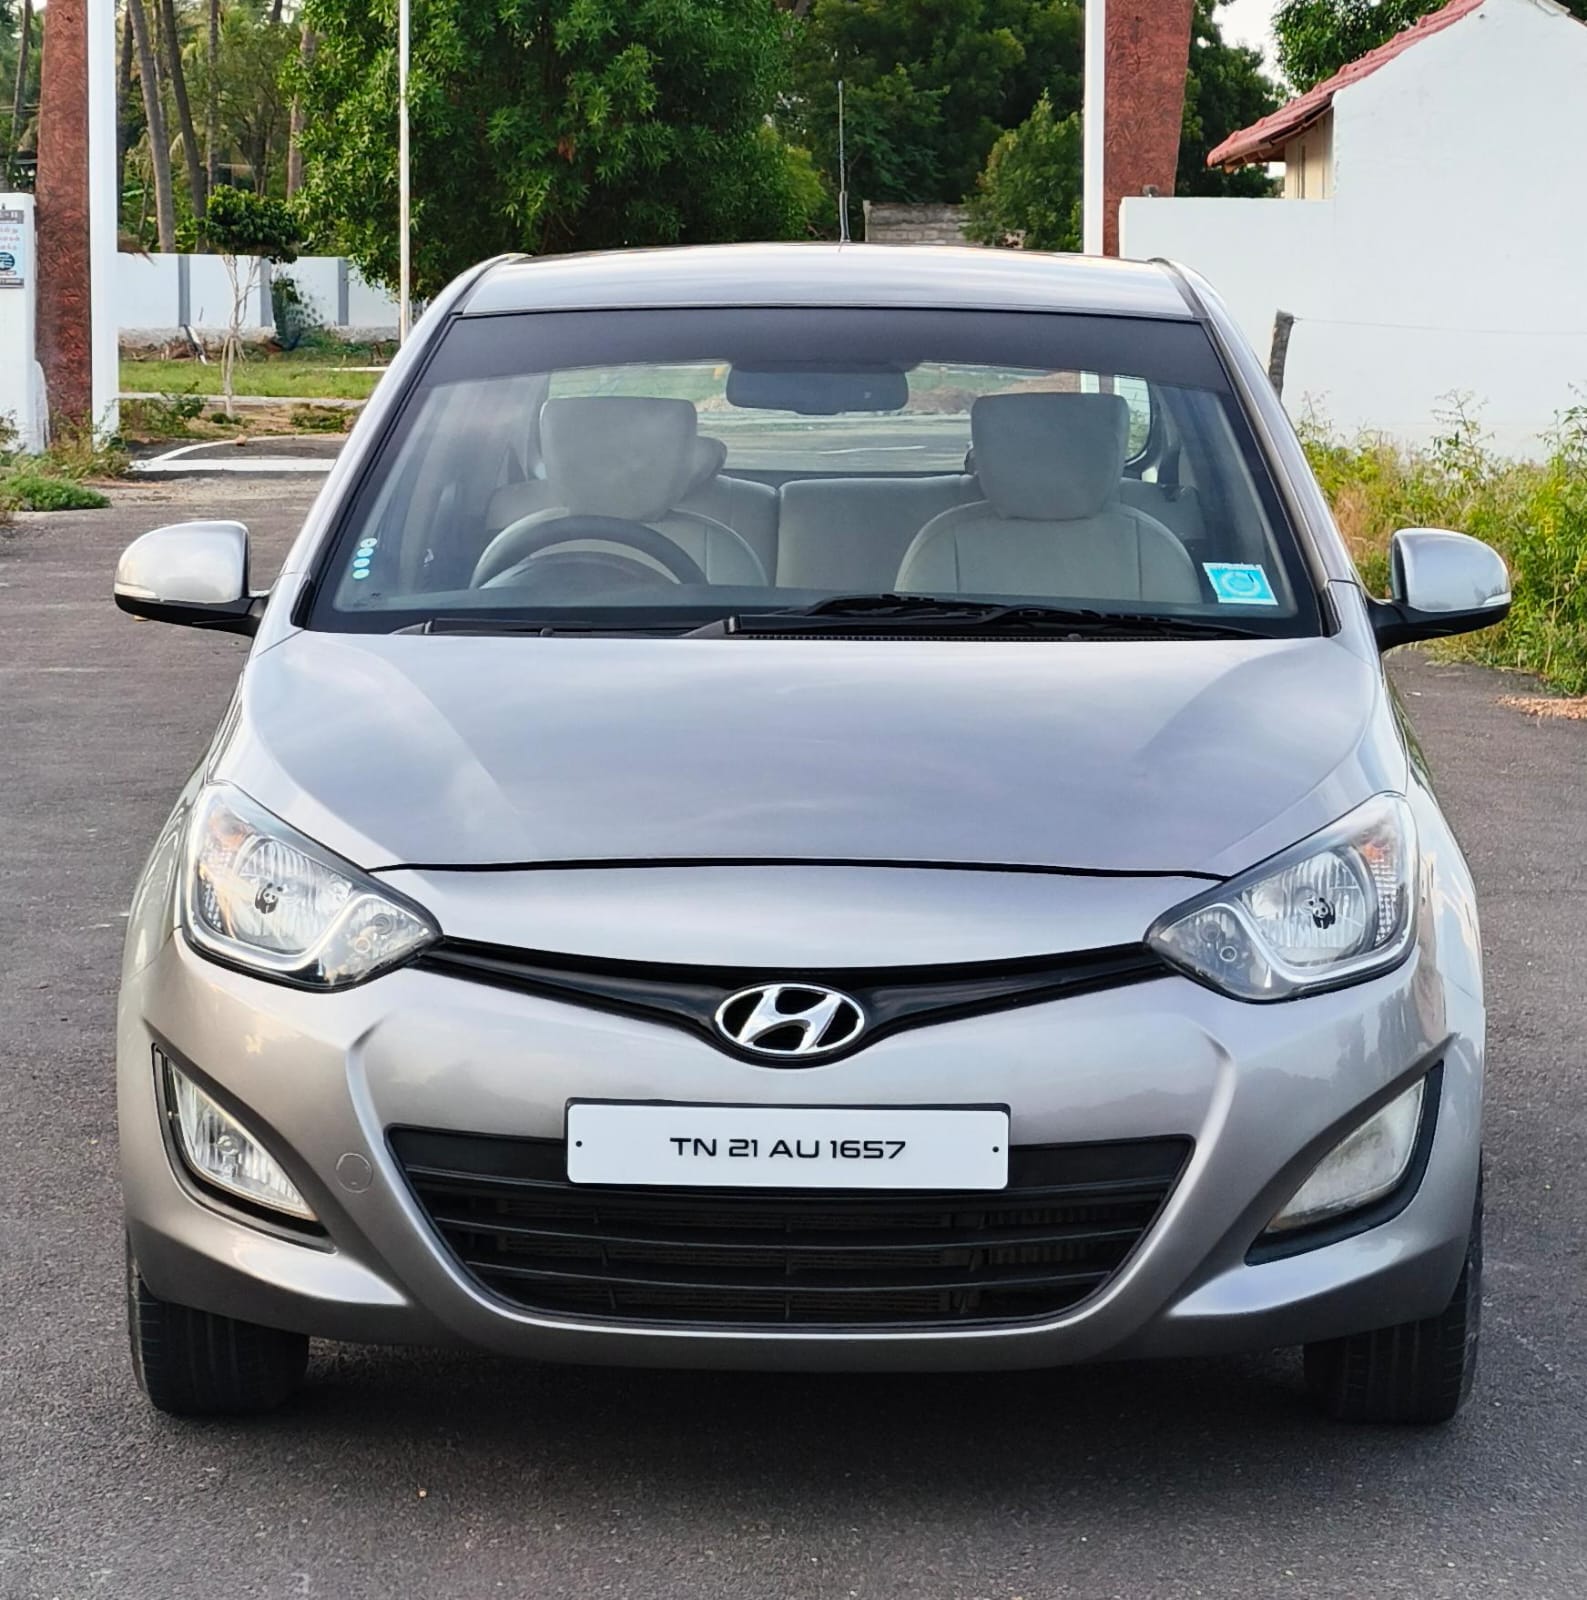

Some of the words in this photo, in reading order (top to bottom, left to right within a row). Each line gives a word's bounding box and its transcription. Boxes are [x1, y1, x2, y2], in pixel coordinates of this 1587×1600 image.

[669, 1137, 717, 1157] TN
[728, 1138, 758, 1158] 21
[768, 1139, 820, 1159] AU
[829, 1140, 906, 1160] 1657
